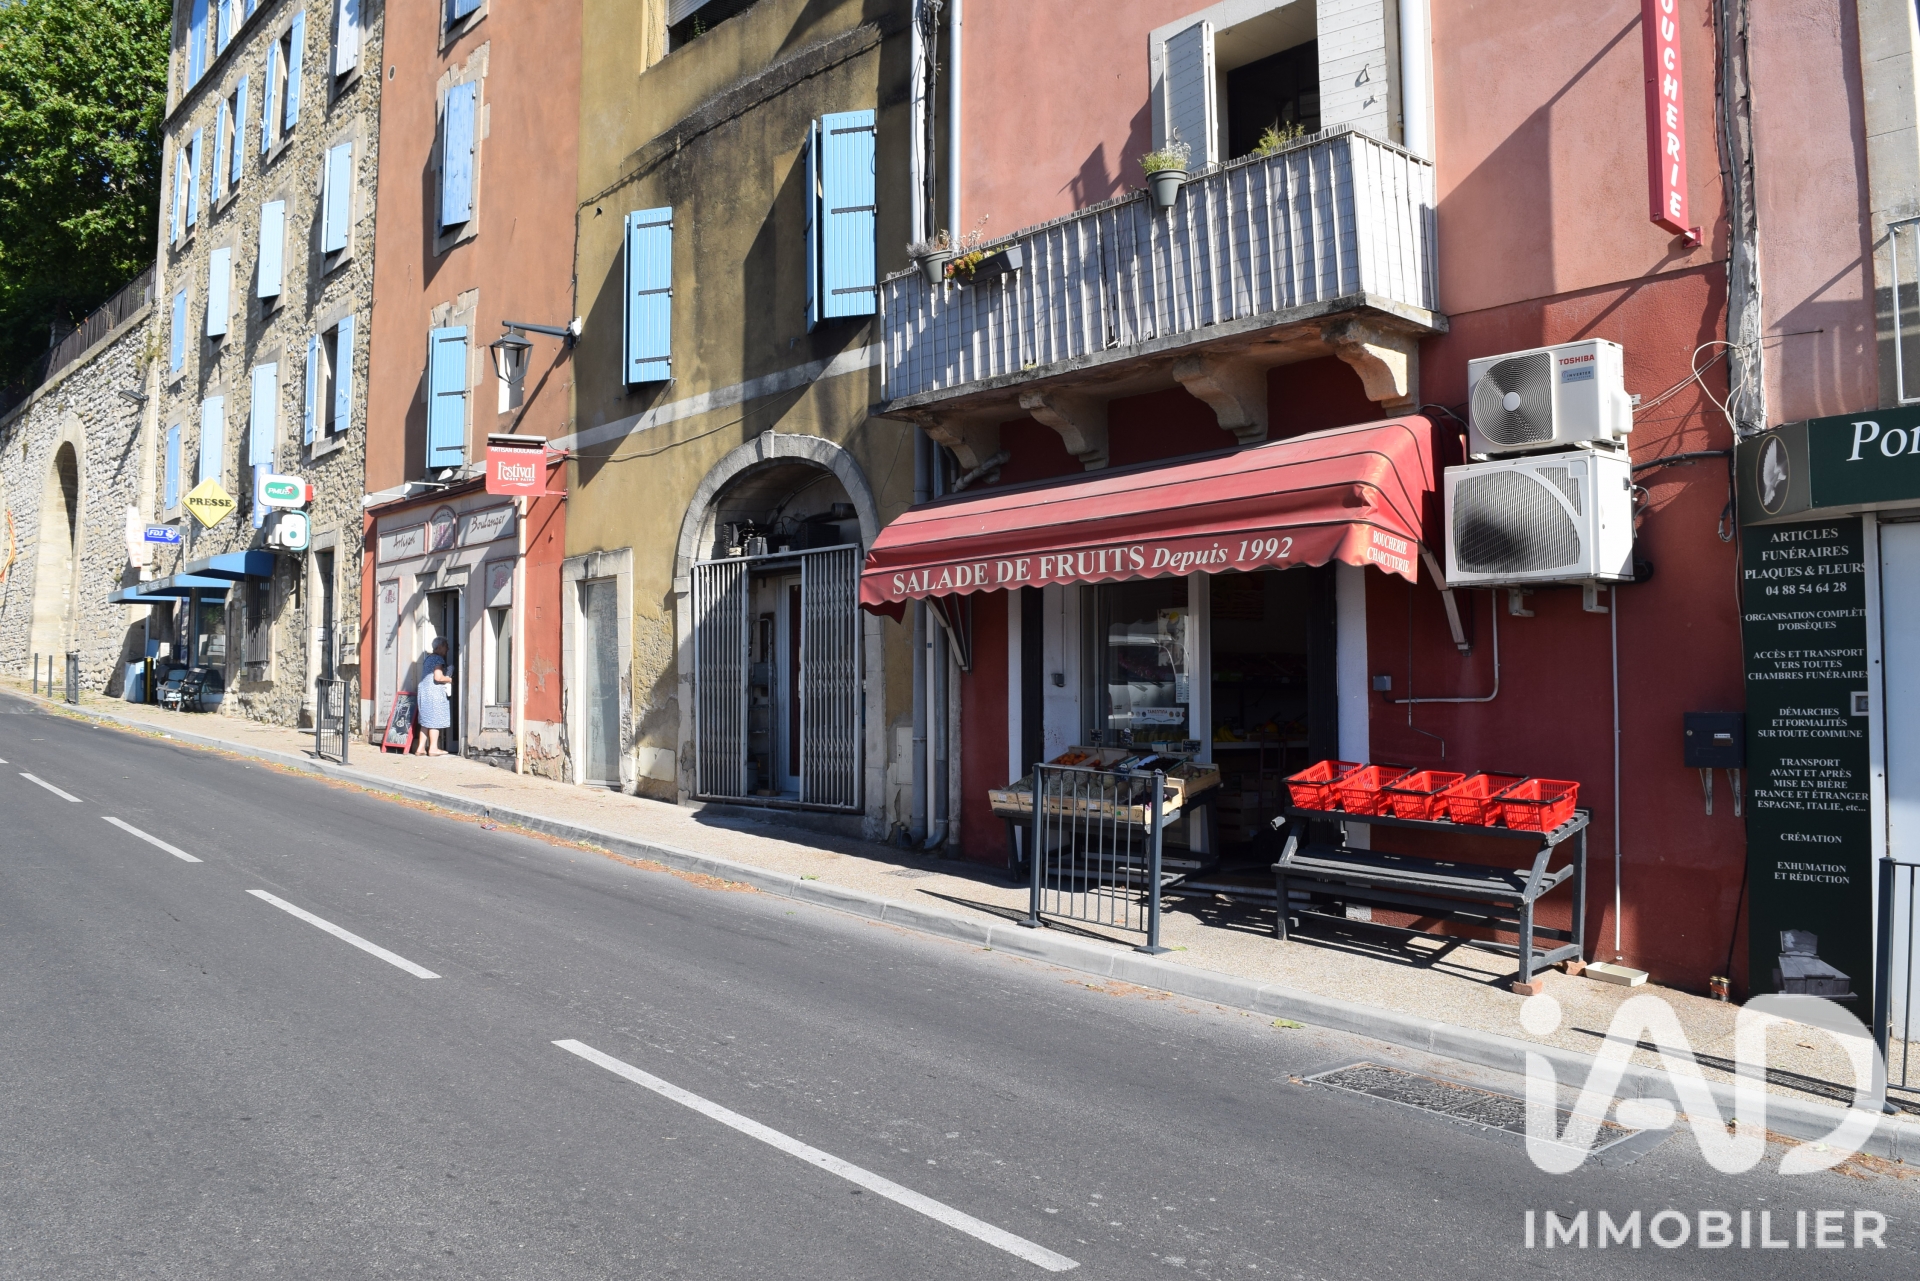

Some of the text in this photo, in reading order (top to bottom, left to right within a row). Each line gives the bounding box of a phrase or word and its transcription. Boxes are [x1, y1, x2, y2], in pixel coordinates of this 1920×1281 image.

[1559, 355, 1594, 365] TOSHIBA
[498, 461, 535, 480] Festival
[189, 497, 232, 507] PRESSE
[470, 512, 506, 534] Boulanger
[393, 534, 416, 549] Artisan
[1770, 528, 1839, 543] ARTICLES
[1373, 530, 1407, 554] BOUCHERIE
[1762, 545, 1849, 561] FUNÉRAIRES
[892, 536, 1294, 596] SALADE DE FRUITS Depuis 1992
[1367, 547, 1410, 573] CHARCUTERIE
[1745, 566, 1802, 579] PLAQUES
[1804, 566, 1816, 576] &
[1766, 582, 1847, 596] 04 88 54 64 28
[1745, 611, 1815, 621] ORGANISATION
[1754, 649, 1864, 659] ACCÈS ET TRANSPORT
[1774, 660, 1843, 669] VERS TOUTES
[1748, 672, 1803, 680] CHAMBRES
[1779, 706, 1840, 716] DÉMARCHES
[1772, 717, 1848, 727] ET FORMALITÉS
[1757, 729, 1862, 738] SUR TOUTE COMMUNE
[1780, 758, 1840, 767] TRANSPORT
[1770, 768, 1852, 778] AVANT ET APRÈS
[1773, 779, 1848, 789] MISE EN BIÈRE
[1754, 789, 1869, 801] FRANCE ET ÉTRANGER
[1757, 800, 1867, 812] ESPAGNE, ITALIE, etc...
[1780, 832, 1842, 844] CRÉMATION
[1777, 861, 1847, 873] EXHUMATION
[1774, 872, 1850, 884] ET RÉDUCTION
